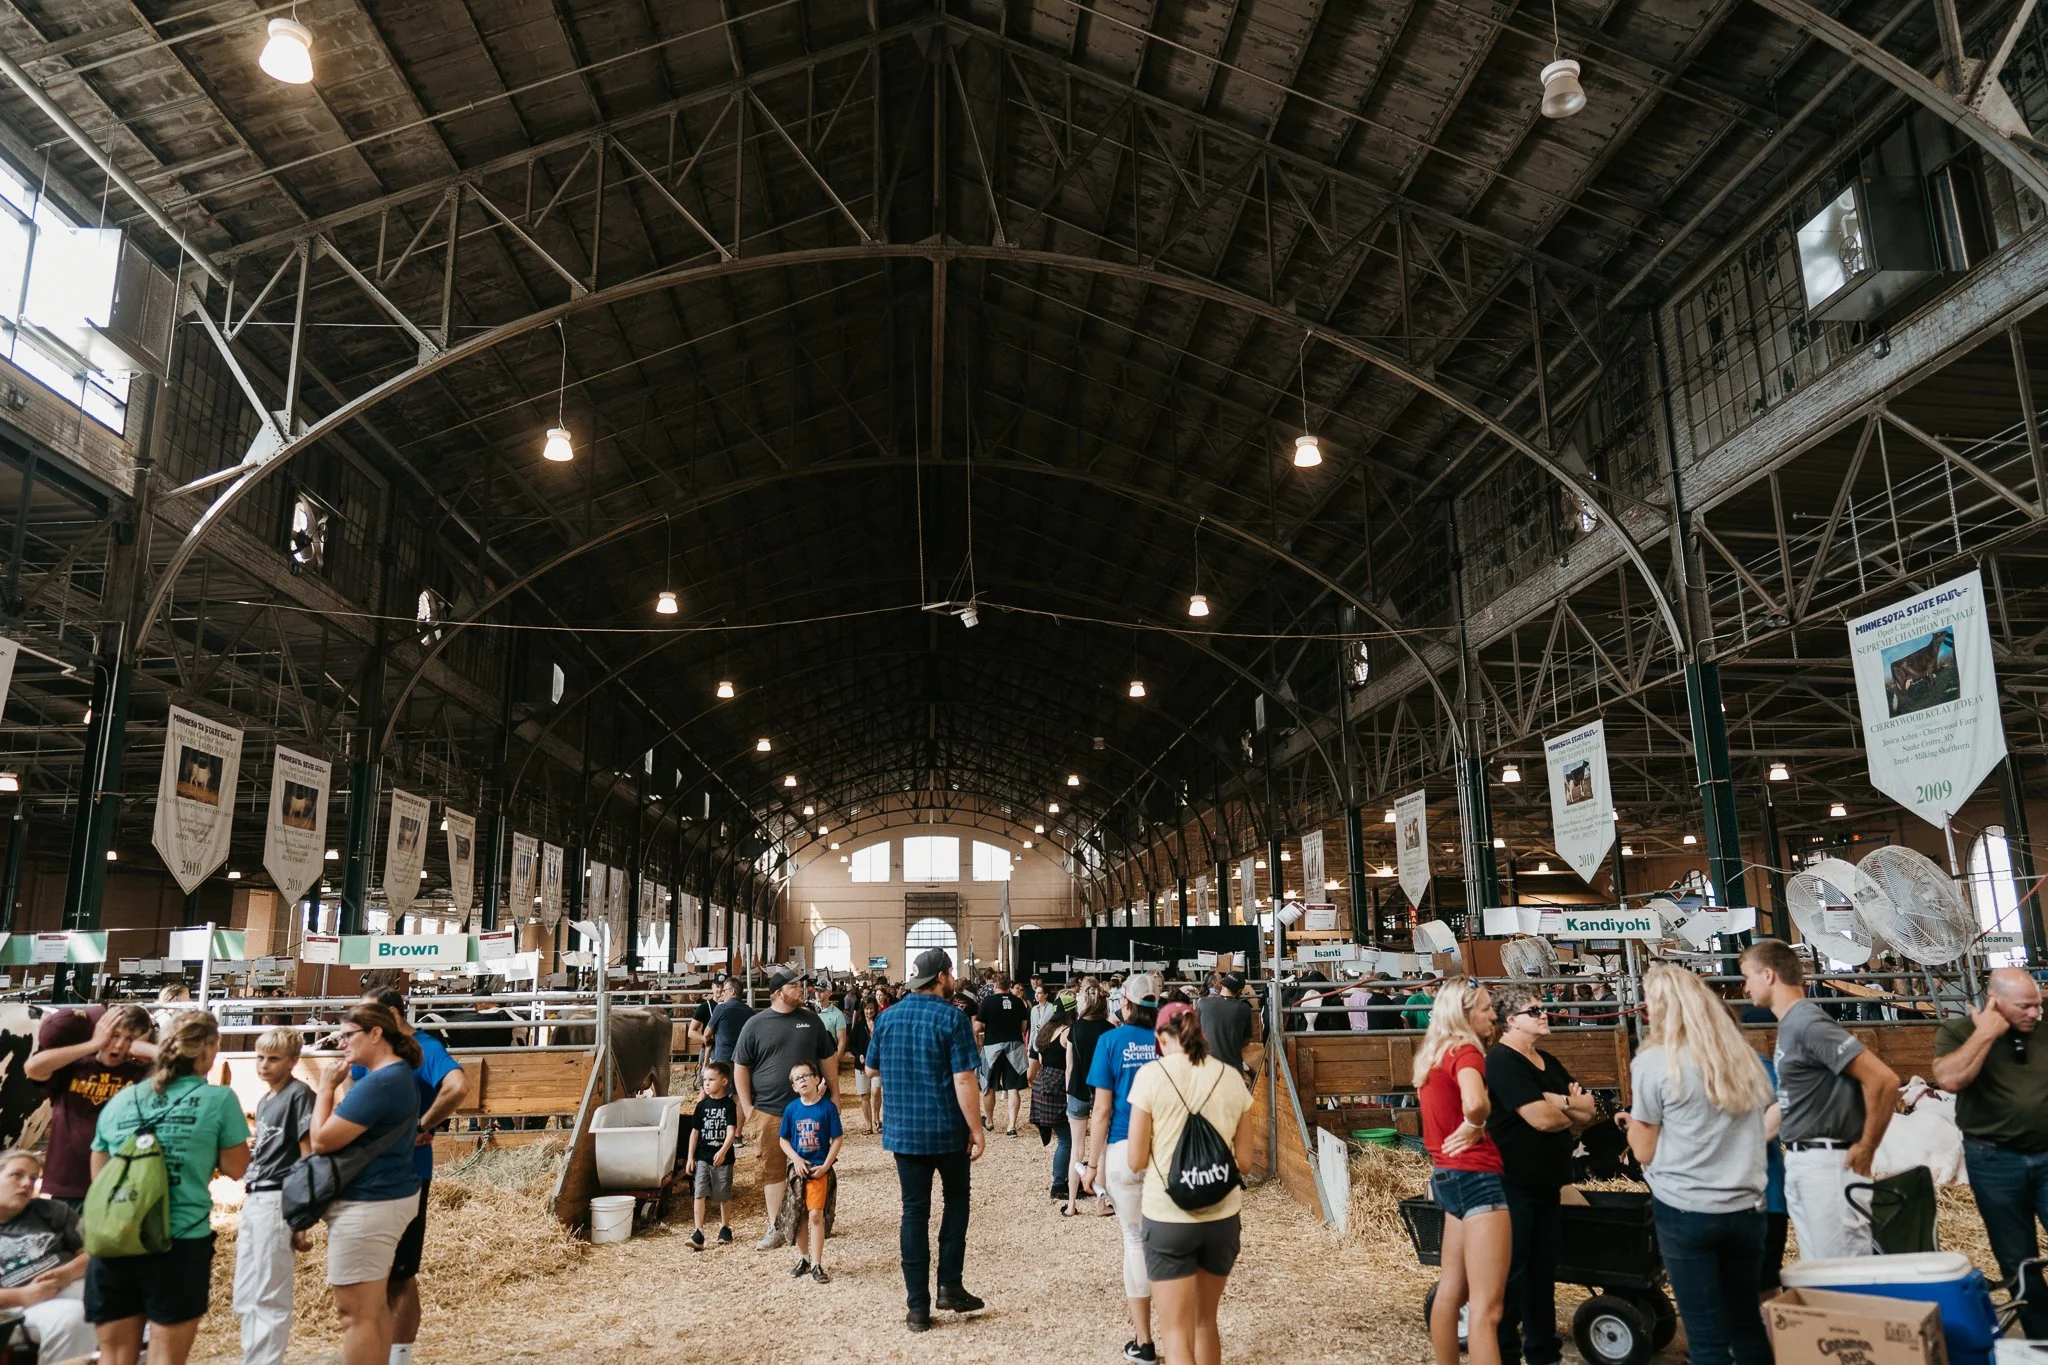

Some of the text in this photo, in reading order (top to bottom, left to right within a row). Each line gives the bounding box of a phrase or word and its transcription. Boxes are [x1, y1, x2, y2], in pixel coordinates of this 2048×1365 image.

[1855, 588, 1963, 636] MINNESOTA STATE FAIR
[1857, 606, 1978, 656] SUPREME CHAMPION FEMALE
[1877, 606, 1950, 639] Open Class Dairy Show
[173, 713, 205, 732] MINNESOTA
[205, 725, 220, 739] STATE
[1916, 779, 1953, 805] 2009
[180, 860, 202, 877] 2010
[1579, 853, 1595, 868] 2010
[286, 878, 302, 892] 2010
[1566, 917, 1651, 934] Kandiyohi
[378, 942, 439, 957] Brown
[1314, 948, 1341, 958] Isanti
[1122, 1048, 1155, 1061] Scient
[69, 1078, 128, 1098] NORTHFIE
[1180, 1162, 1229, 1190] xfinity
